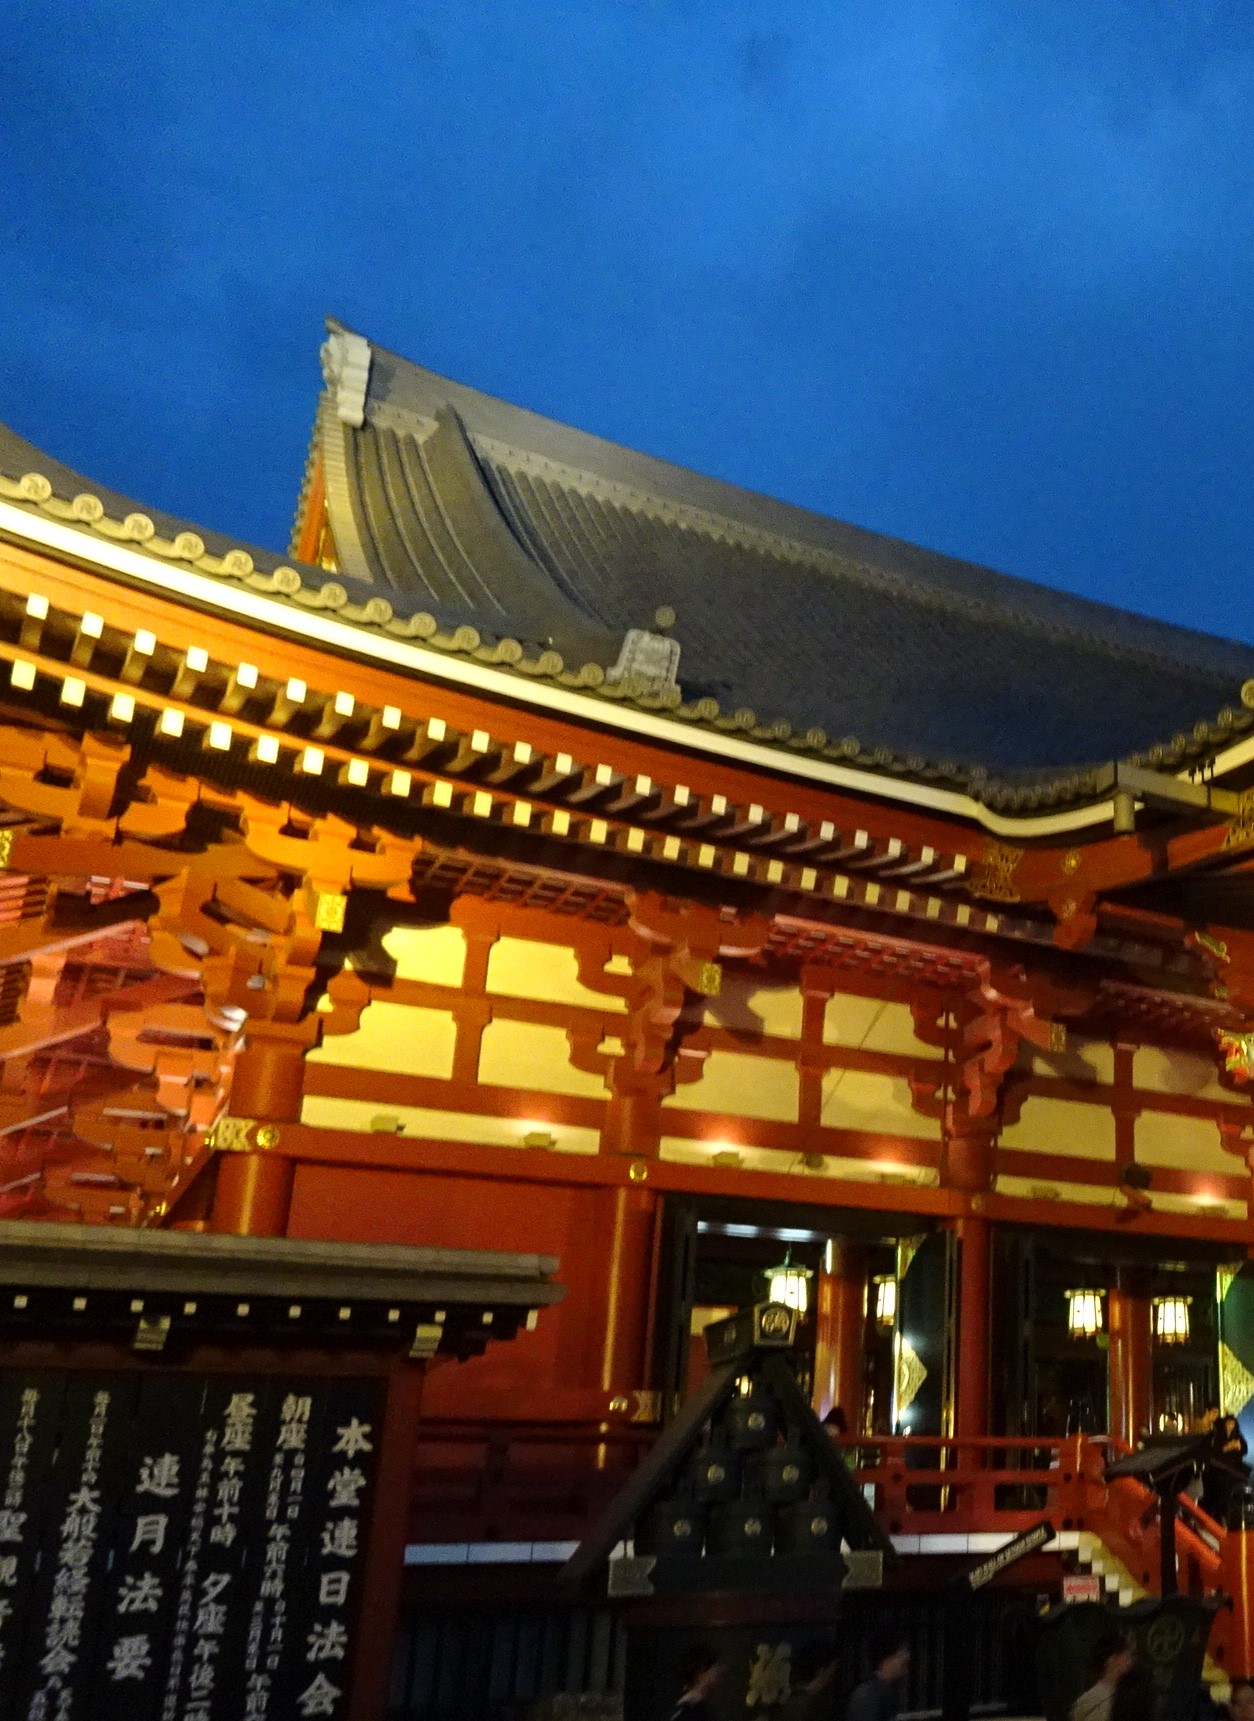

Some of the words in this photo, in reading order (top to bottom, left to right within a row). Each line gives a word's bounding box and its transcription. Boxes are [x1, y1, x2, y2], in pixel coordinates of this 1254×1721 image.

[106, 1452, 180, 1683] 連月法要
[296, 1416, 374, 1718] 本堂連日法会
